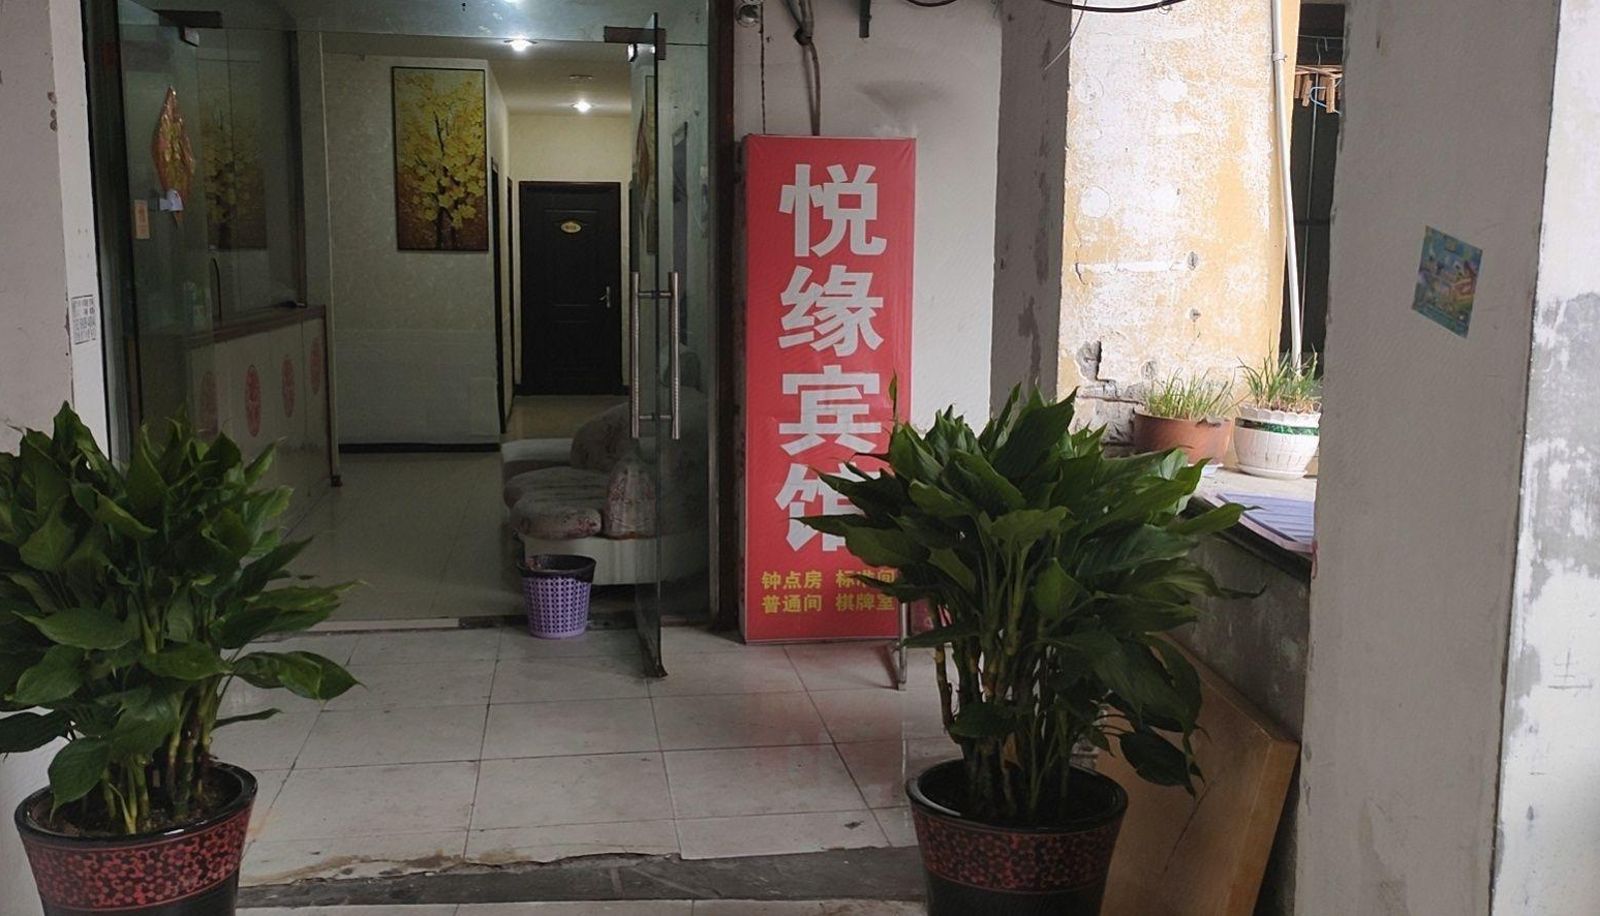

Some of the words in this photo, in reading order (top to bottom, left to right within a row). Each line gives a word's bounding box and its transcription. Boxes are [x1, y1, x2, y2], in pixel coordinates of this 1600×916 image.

[776, 163, 888, 552] 悦缘宾馆
[762, 570, 823, 590] 钟点房
[762, 594, 823, 613] 普通间
[836, 593, 895, 611] 棋牌室
